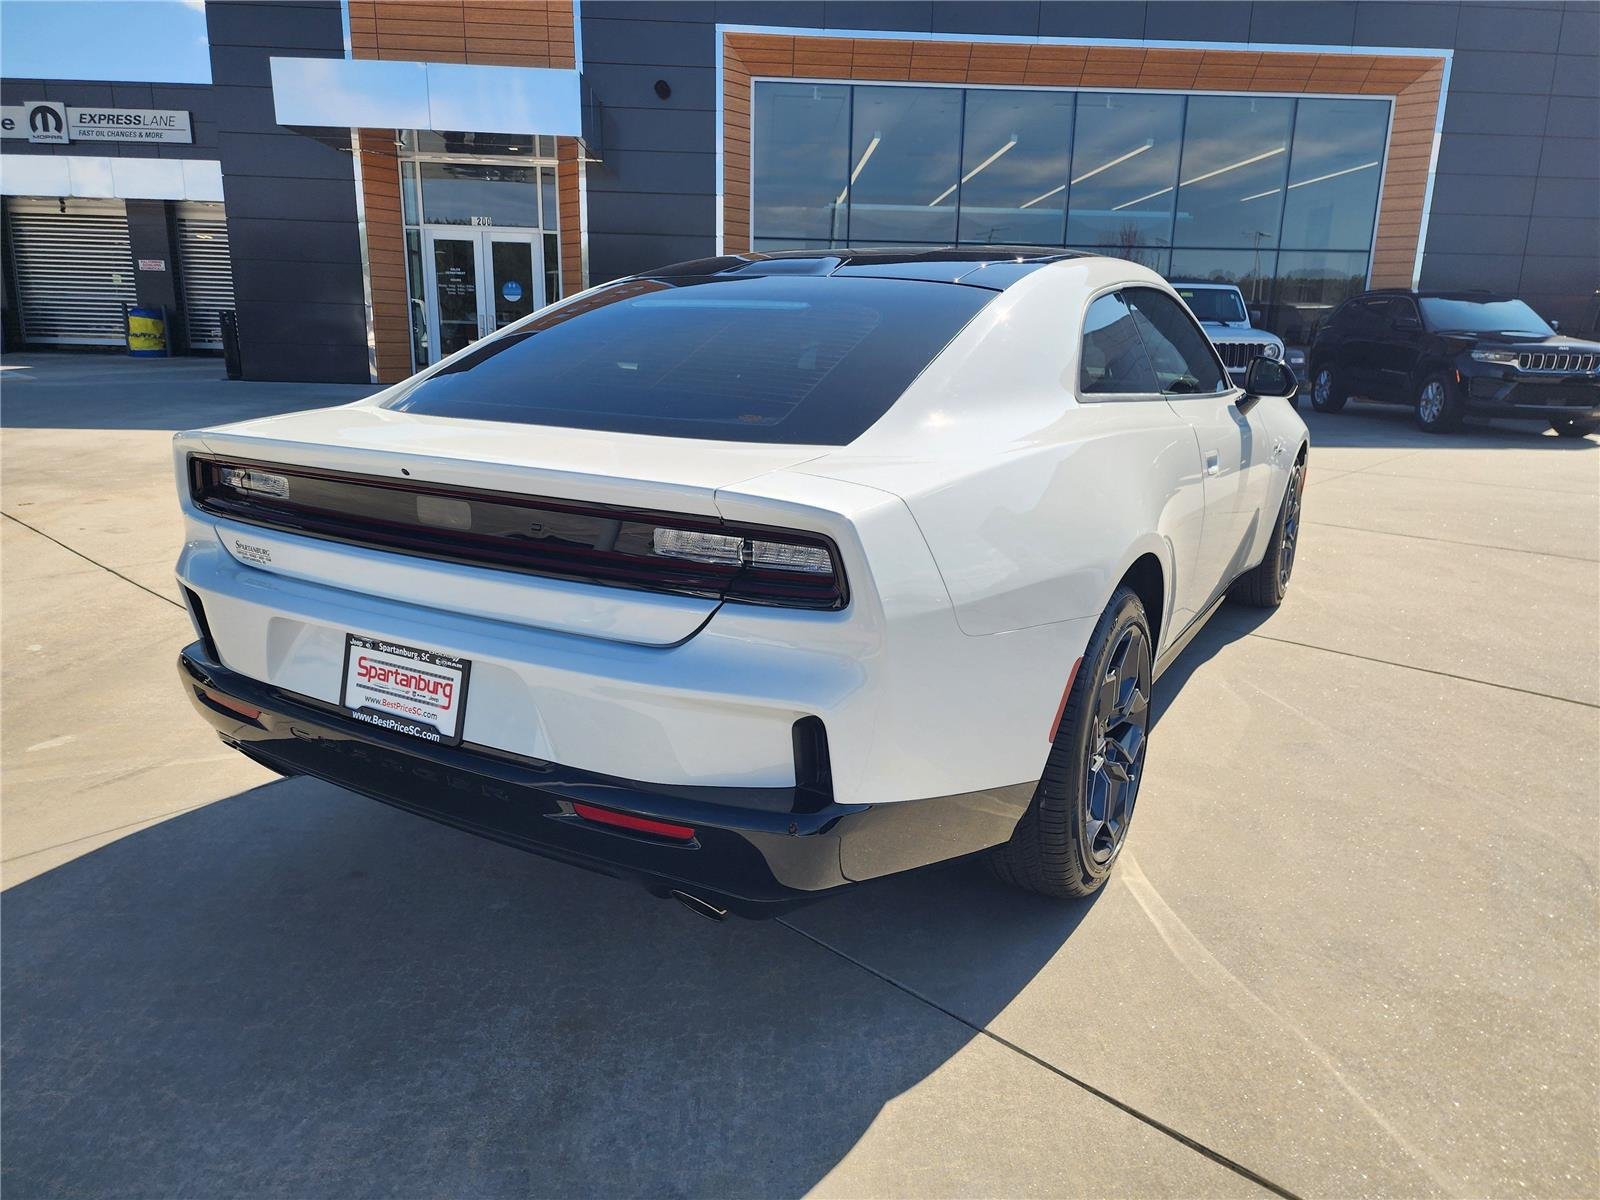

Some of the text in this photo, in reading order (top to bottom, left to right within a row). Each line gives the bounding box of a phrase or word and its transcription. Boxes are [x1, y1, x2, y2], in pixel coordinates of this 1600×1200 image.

[78, 129, 95, 137] FAST
[106, 130, 136, 138] CHANGES
[144, 131, 164, 139] MORE
[378, 642, 420, 661] Spartanburg,
[421, 652, 430, 662] SC
[357, 655, 454, 710] Spartanburg
[364, 695, 438, 720] www.BestPriceSC.com
[351, 710, 440, 742] www.BestPriceSC.com
